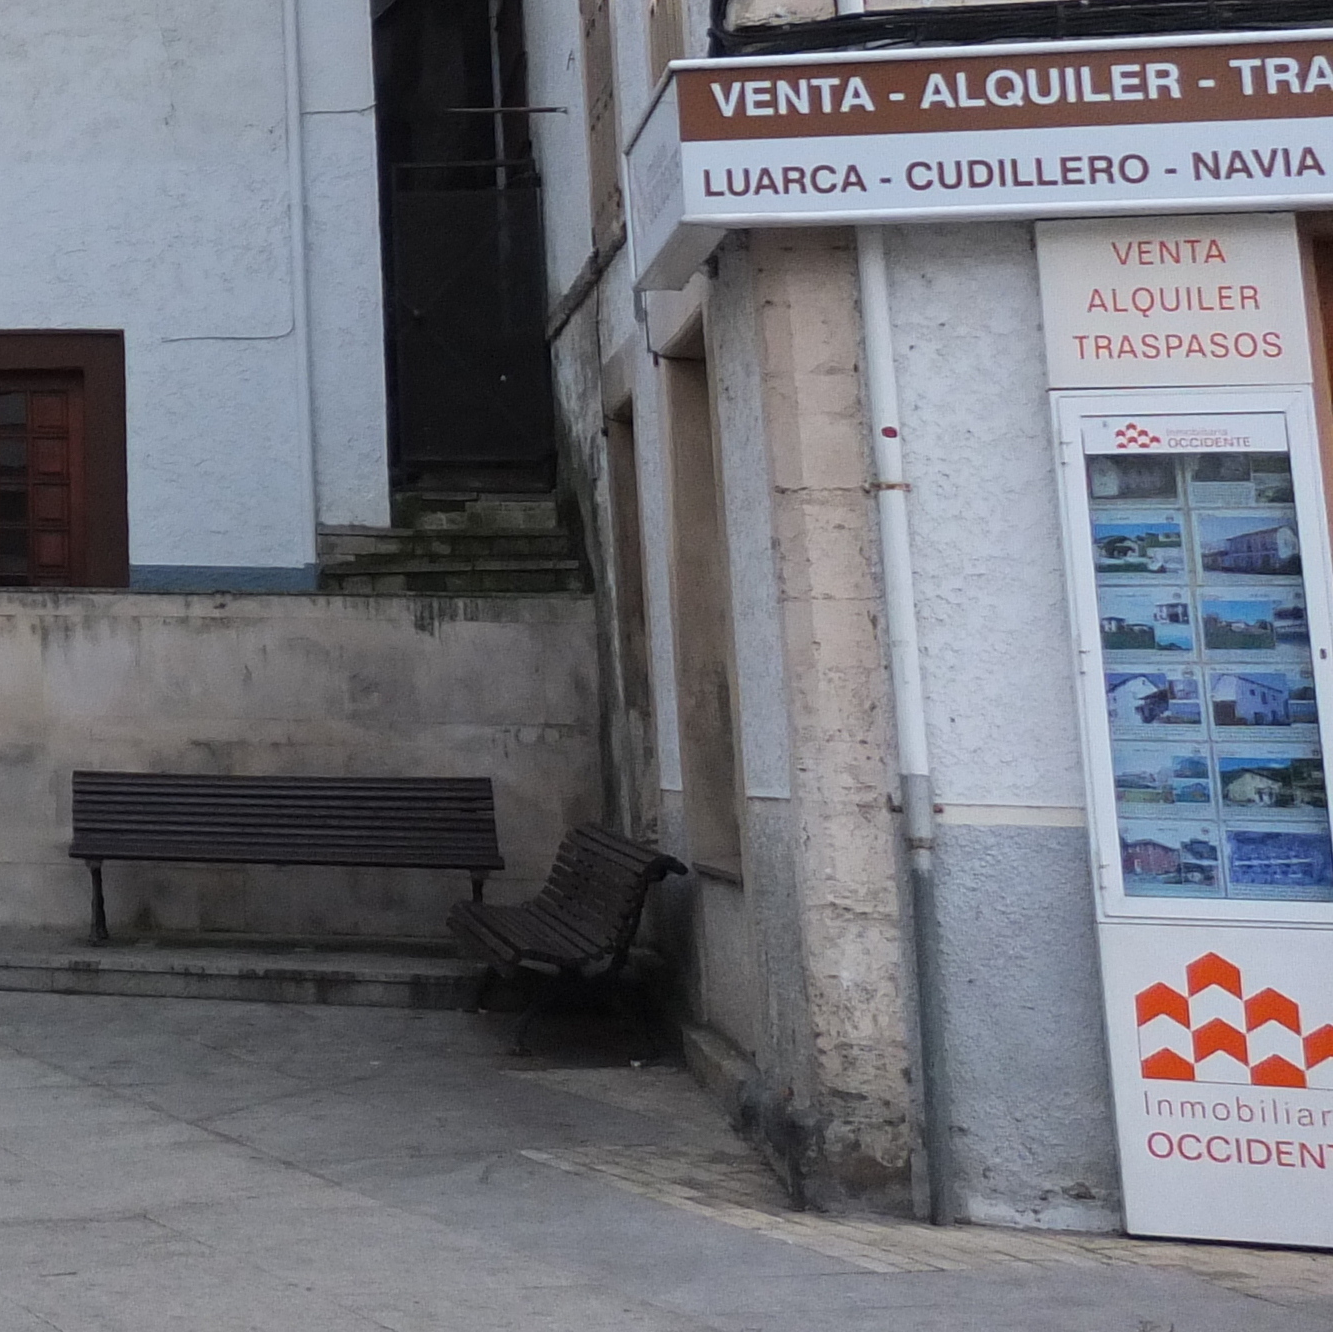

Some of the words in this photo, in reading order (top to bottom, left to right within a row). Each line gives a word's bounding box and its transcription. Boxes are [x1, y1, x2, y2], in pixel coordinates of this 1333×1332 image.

[710, 75, 875, 118] VENTA
[920, 61, 1182, 110] ALQUILER
[1228, 54, 1333, 96] TRA
[703, 163, 867, 198] LUARCA
[904, 152, 1150, 192] CUDILLERO
[1191, 146, 1326, 181] NAVIA
[1110, 238, 1227, 266] VENTA
[1087, 284, 1261, 318] ALQUILER
[1072, 330, 1284, 363] TRASPASOS
[1167, 436, 1251, 448] OCCIDENTE
